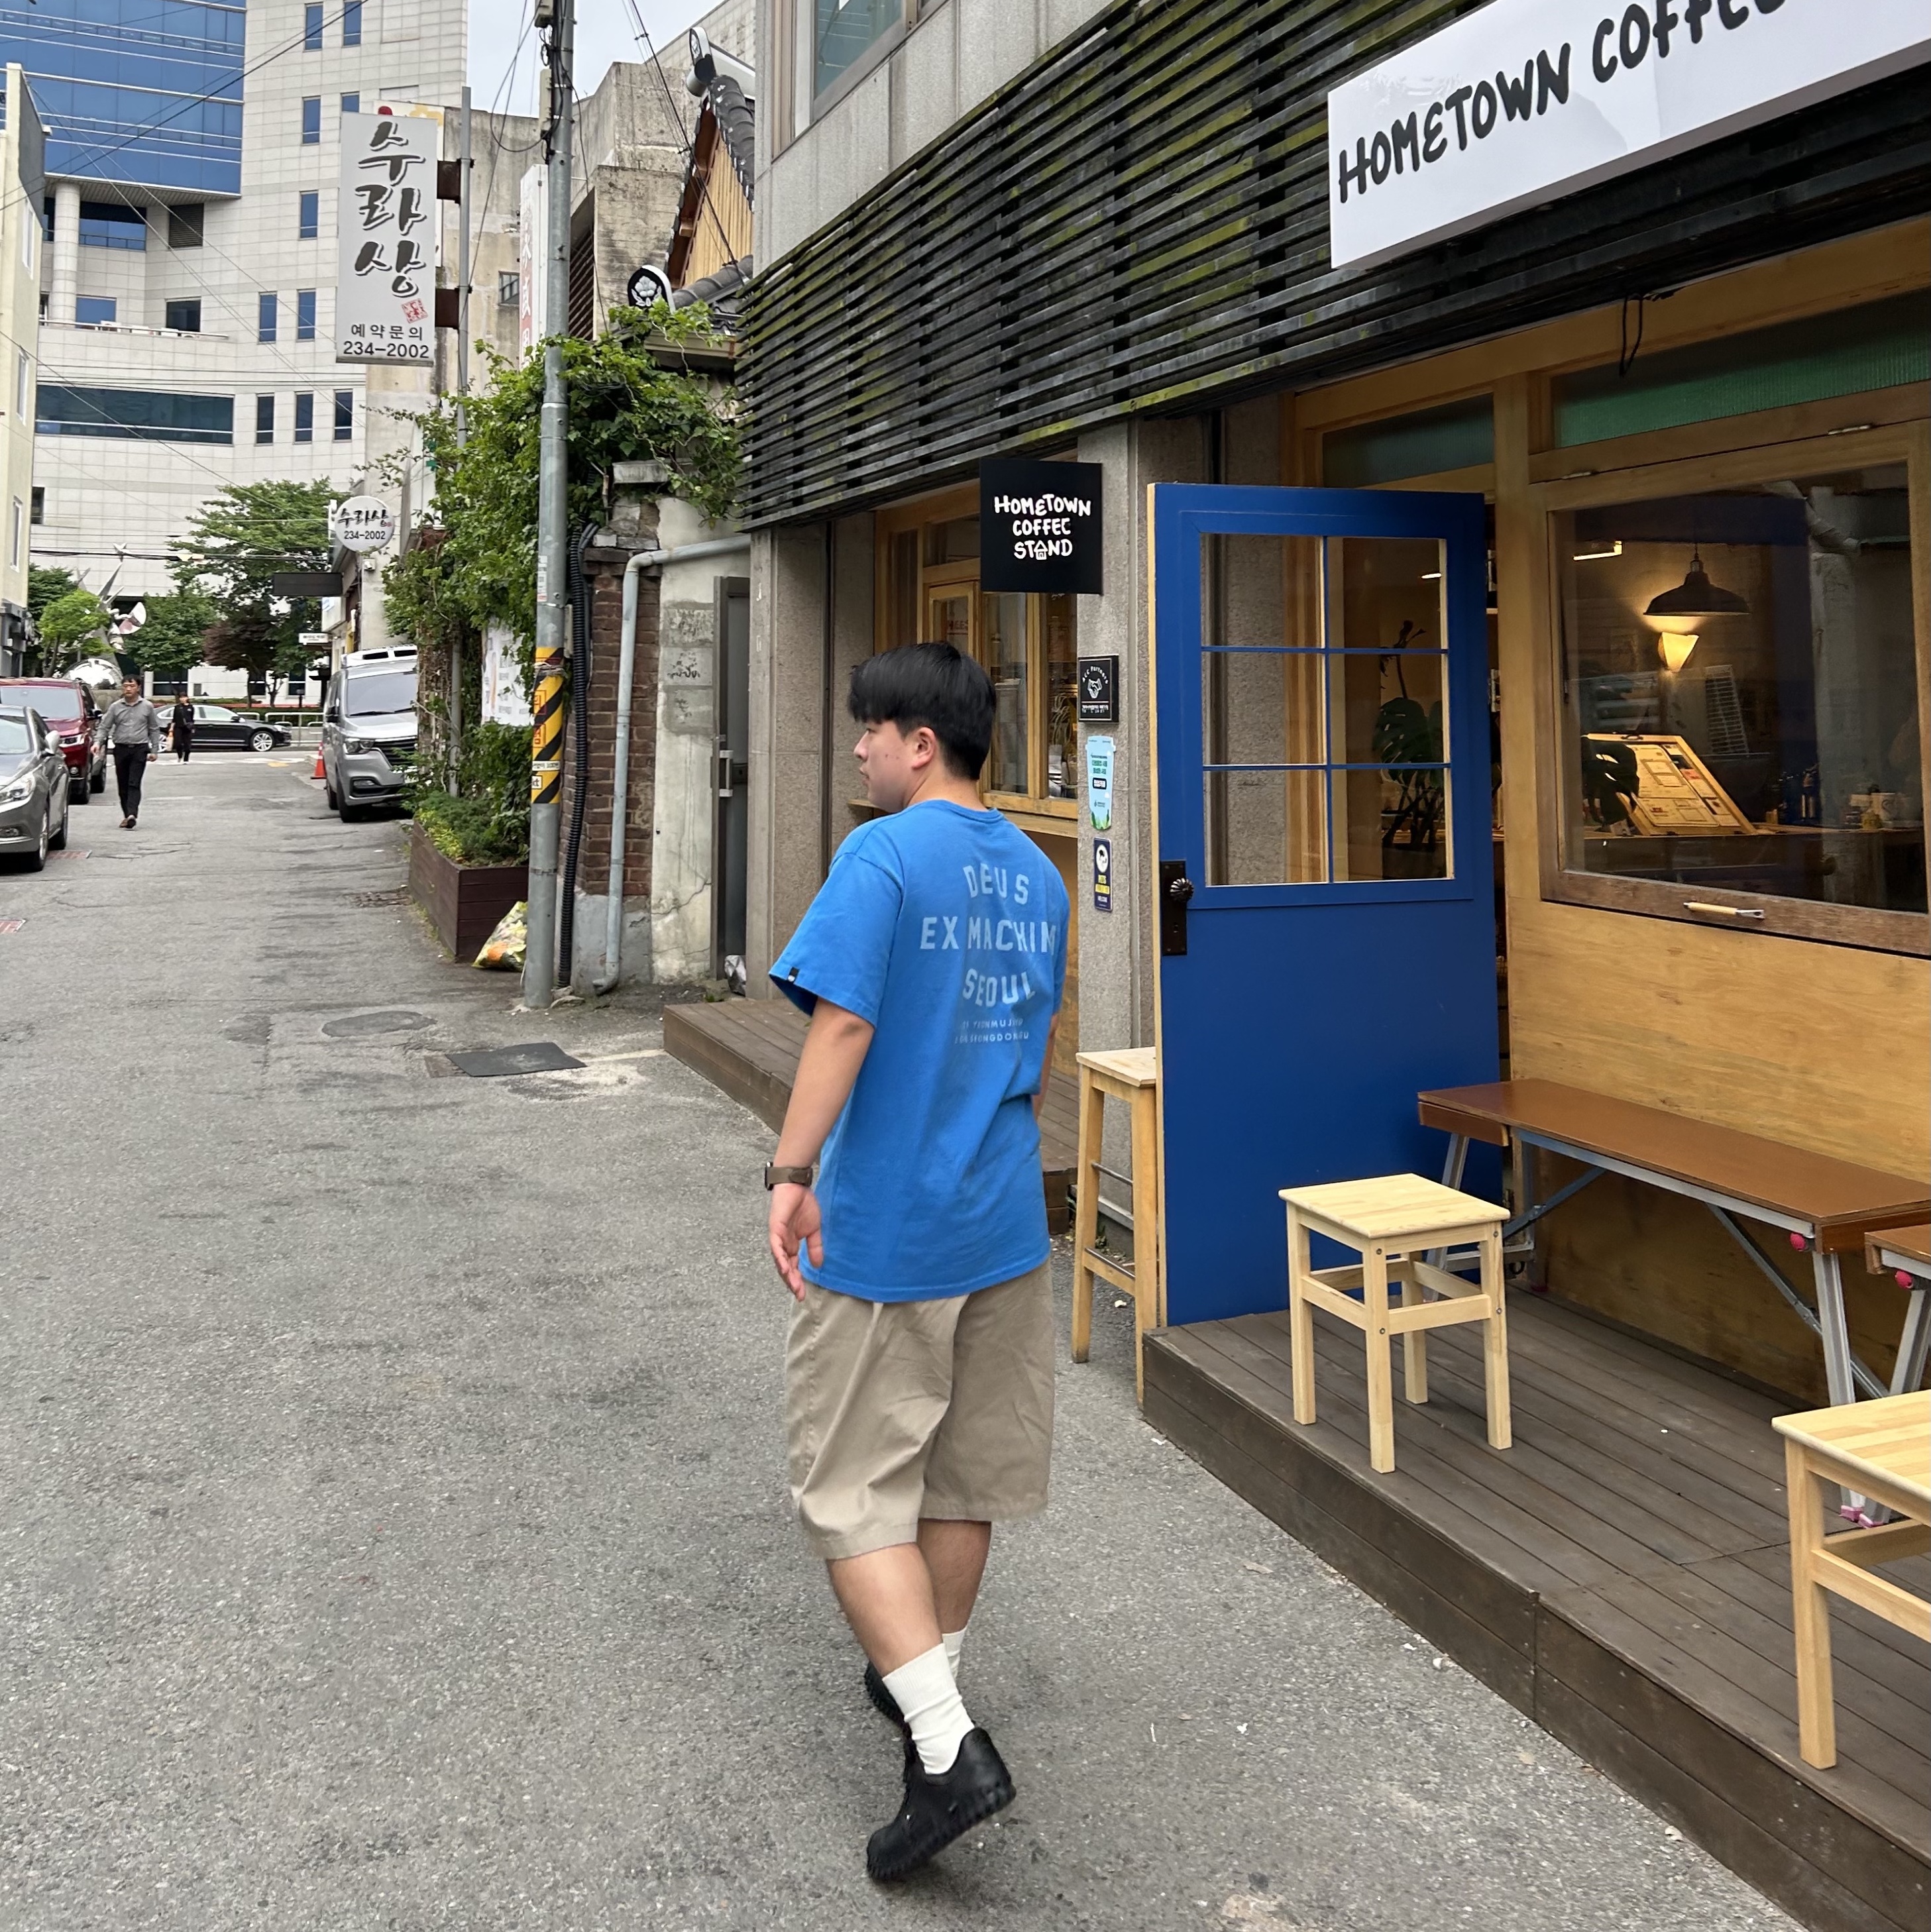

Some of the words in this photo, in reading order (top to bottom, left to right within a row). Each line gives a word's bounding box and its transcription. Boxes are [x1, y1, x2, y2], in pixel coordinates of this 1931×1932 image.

[1339, 42, 1572, 203] HOMETOWN
[1592, 0, 1785, 83] COFF
[354, 121, 427, 297] 수라상
[351, 323, 423, 341] 예약문의
[343, 341, 429, 358] 234-2002
[337, 508, 390, 527] 수라상
[994, 494, 1092, 517] HOMETOWN
[344, 530, 386, 540] 234-2002
[962, 863, 1030, 906] DEUS
[920, 916, 960, 951] EX
[962, 967, 1036, 1008] SEOUL
